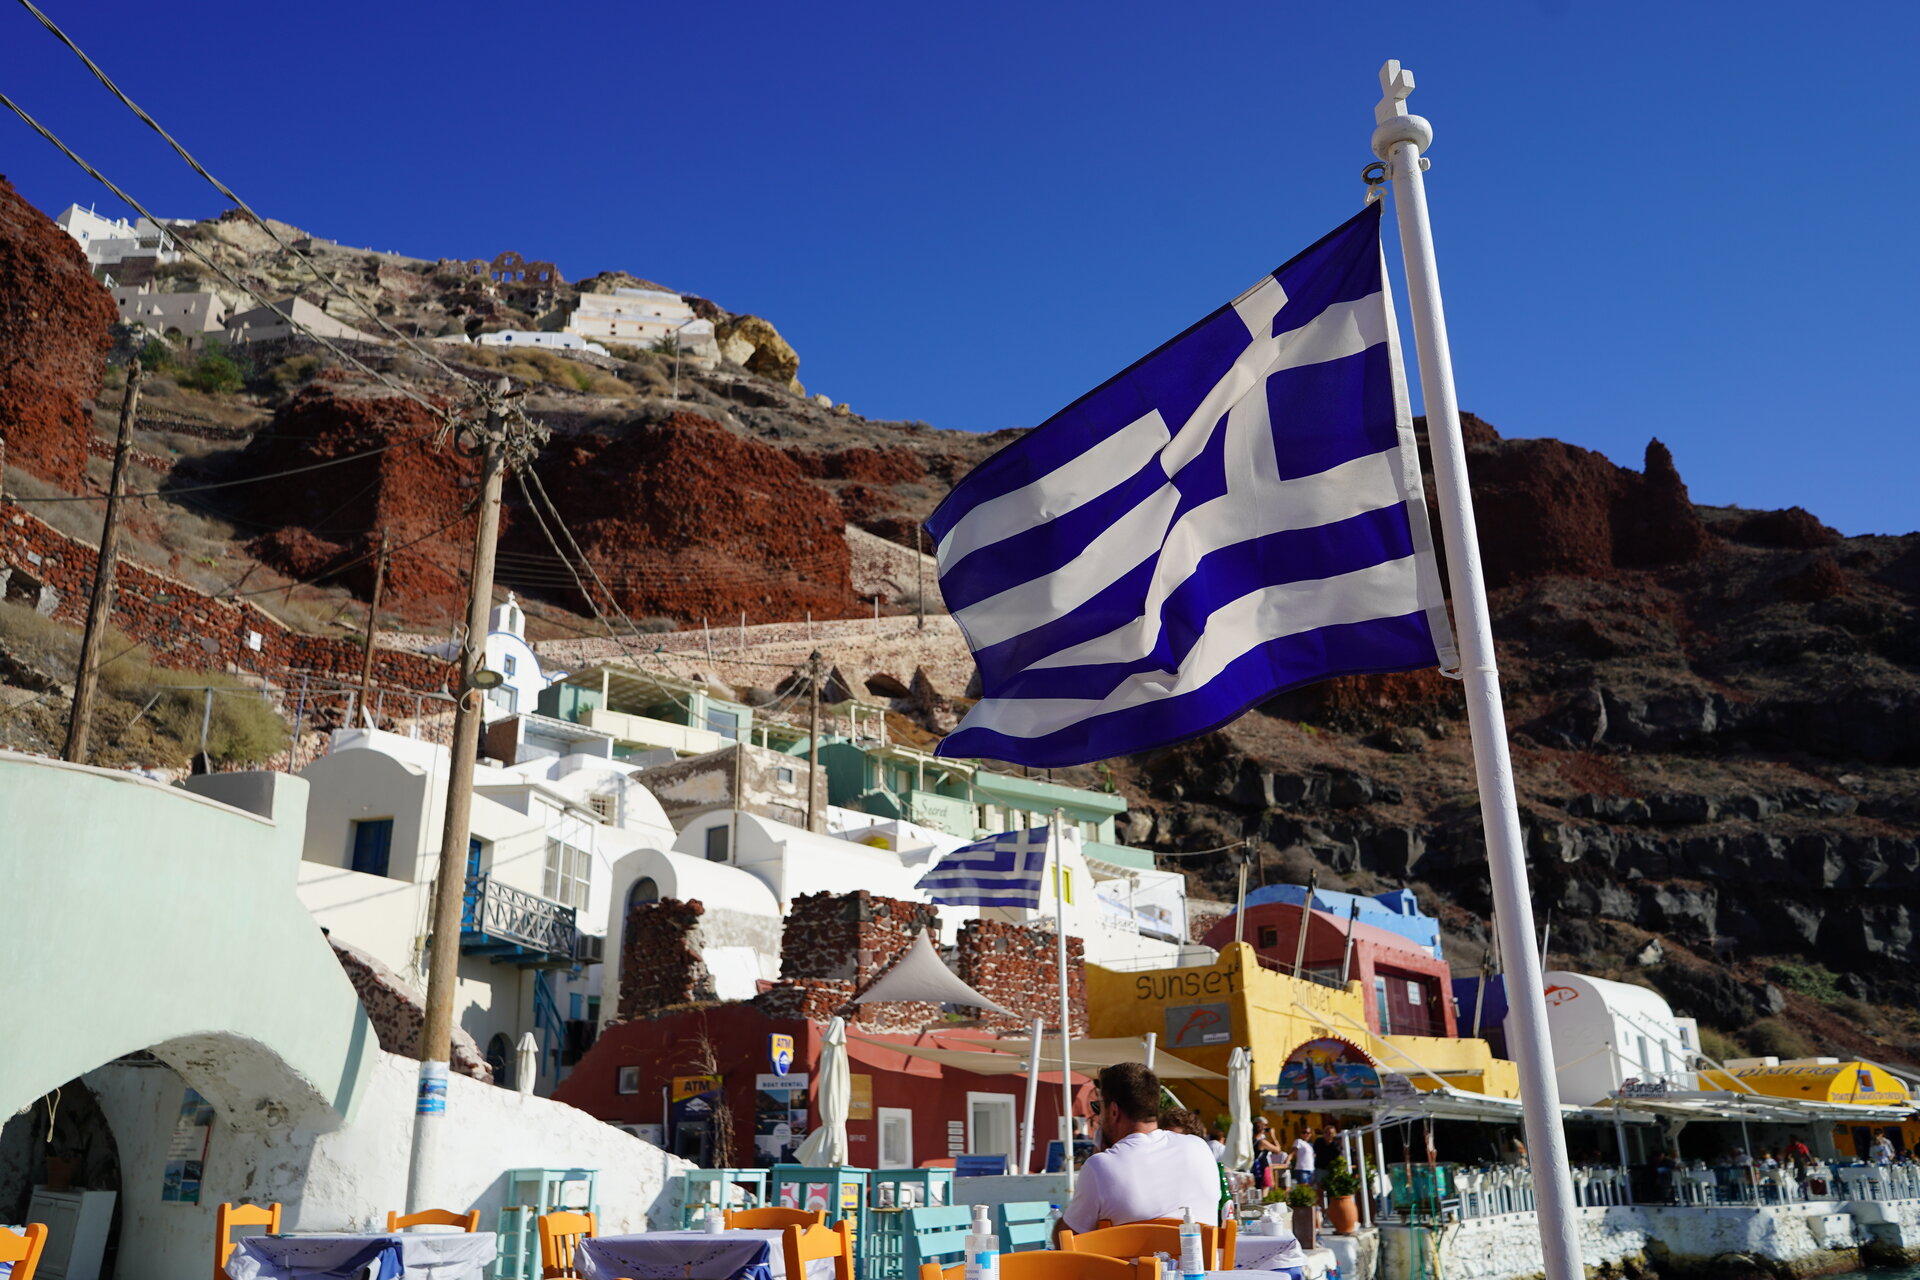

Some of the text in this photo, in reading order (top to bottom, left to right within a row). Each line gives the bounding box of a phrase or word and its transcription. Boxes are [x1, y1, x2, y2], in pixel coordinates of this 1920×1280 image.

[921, 799, 948, 818] Secret
[1136, 967, 1236, 1000] sunset
[776, 1038, 791, 1047] ATM
[1735, 1066, 1841, 1078] DIMITRIS
[683, 1081, 711, 1092] ATM
